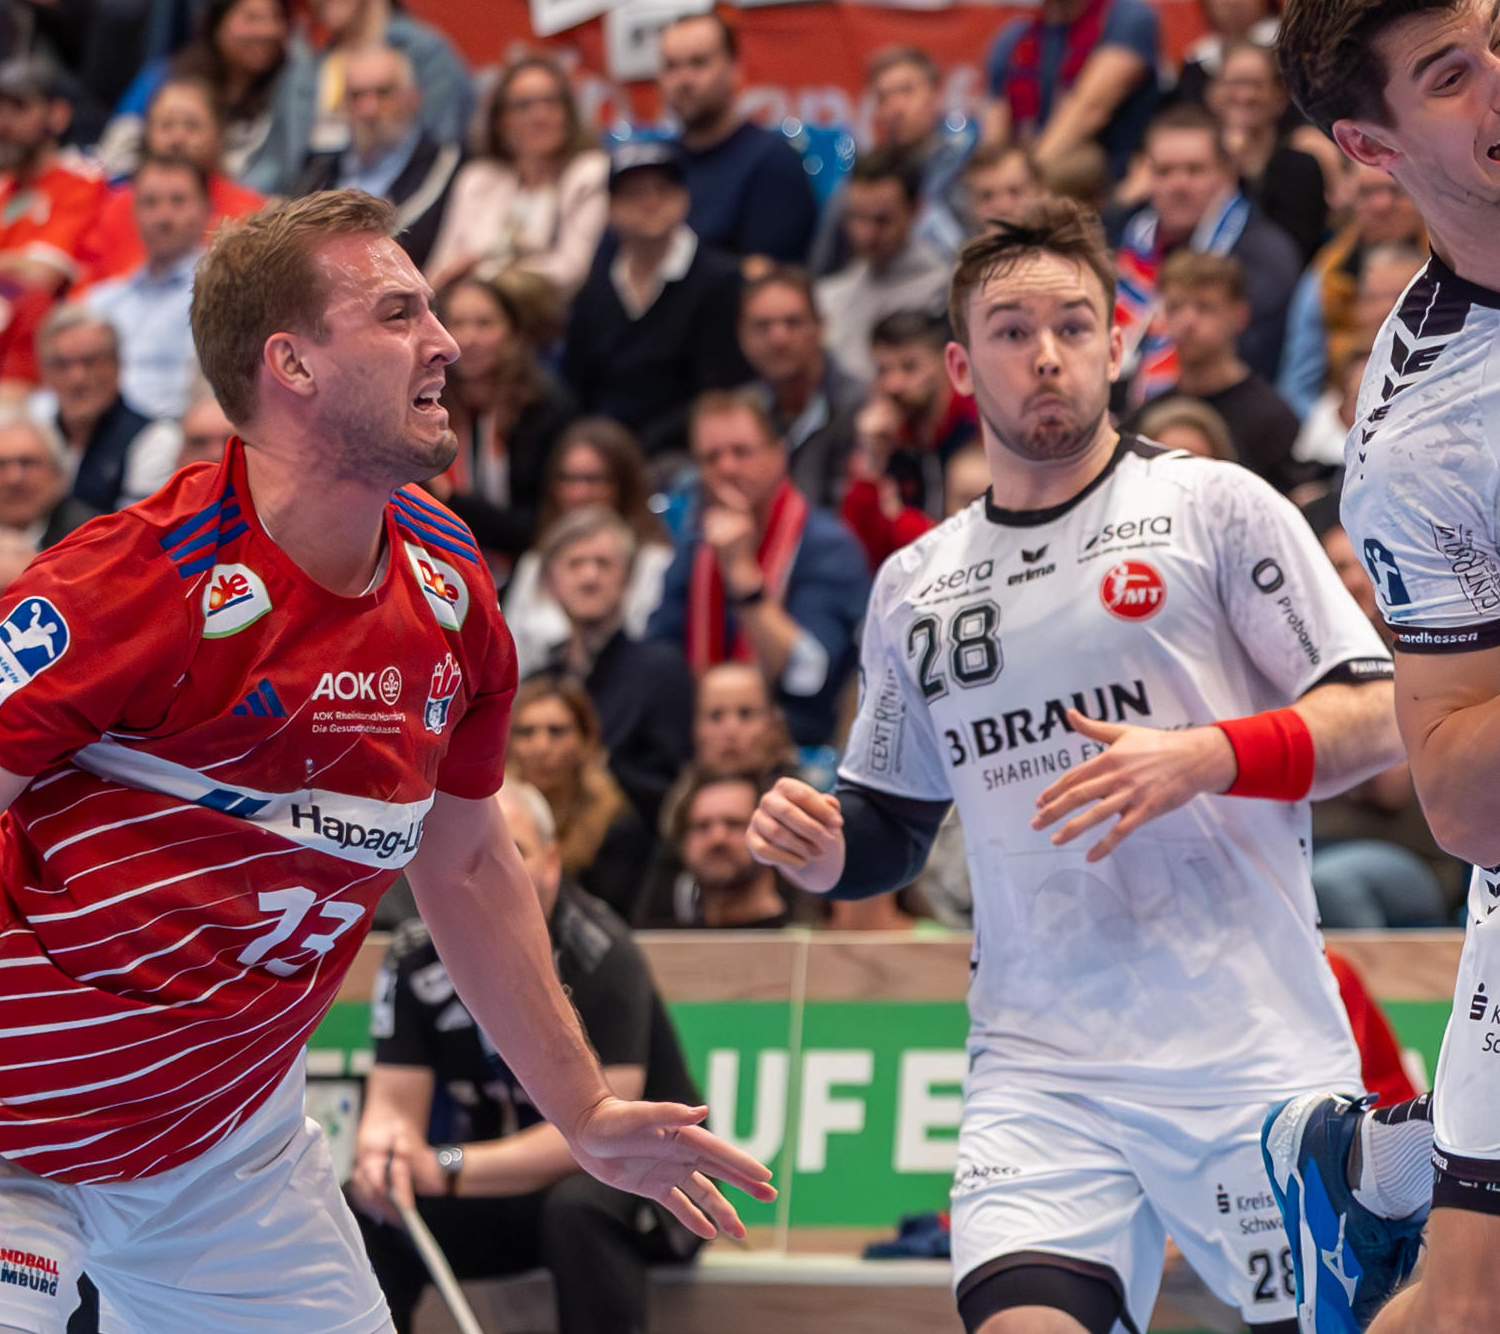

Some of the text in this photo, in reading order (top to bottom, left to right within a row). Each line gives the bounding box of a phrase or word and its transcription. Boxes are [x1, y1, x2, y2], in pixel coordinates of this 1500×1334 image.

[1102, 516, 1173, 543] sera
[934, 559, 995, 594] sera
[1007, 563, 1057, 587] erima
[1124, 586, 1164, 606] MT
[907, 597, 1004, 707] 28
[311, 671, 378, 701] AOK
[312, 712, 334, 722] AOK
[970, 679, 1153, 759] BRAUN
[982, 748, 1073, 792] SHARING
[236, 885, 367, 978] 73
[704, 1046, 966, 1175] UFE
